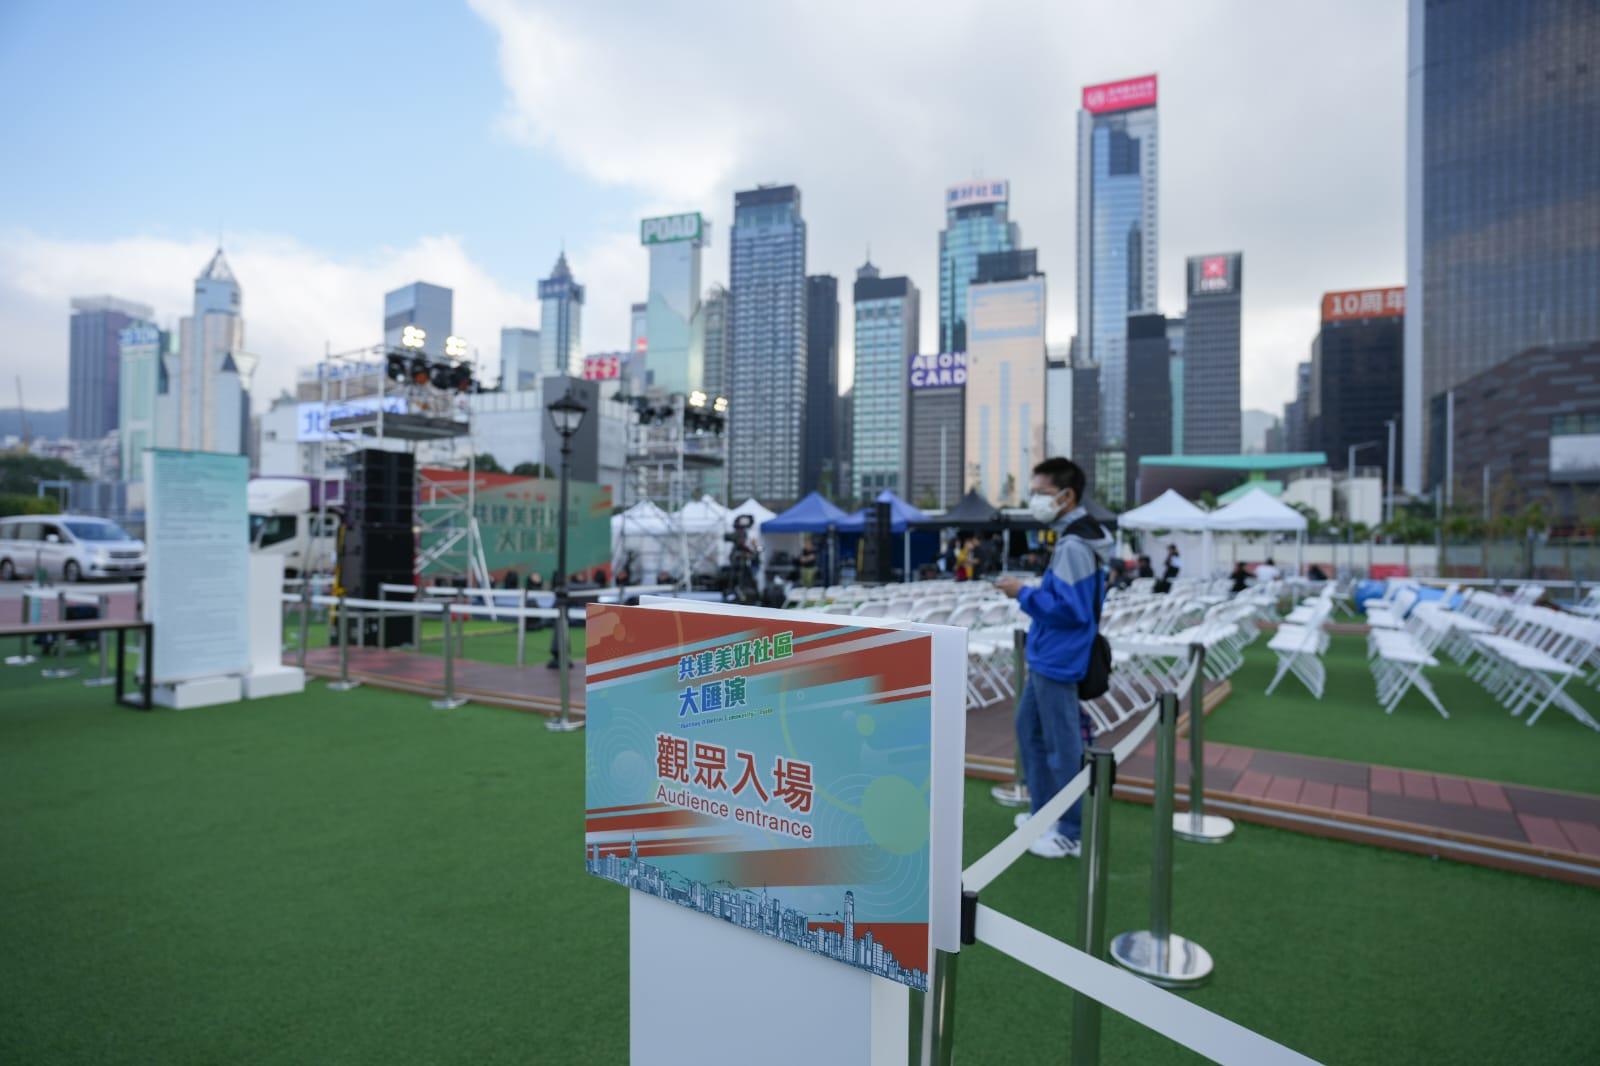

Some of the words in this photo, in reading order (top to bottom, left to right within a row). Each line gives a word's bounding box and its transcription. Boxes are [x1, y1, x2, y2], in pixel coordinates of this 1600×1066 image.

[643, 215, 699, 243] POAD
[911, 368, 966, 386] CARD
[912, 352, 967, 369] AEON
[679, 632, 793, 681] 共建美好社區
[679, 676, 746, 717] 大匯演
[657, 734, 813, 813] 觀眾入場
[656, 784, 729, 817] Audience
[735, 807, 812, 839] entrance
